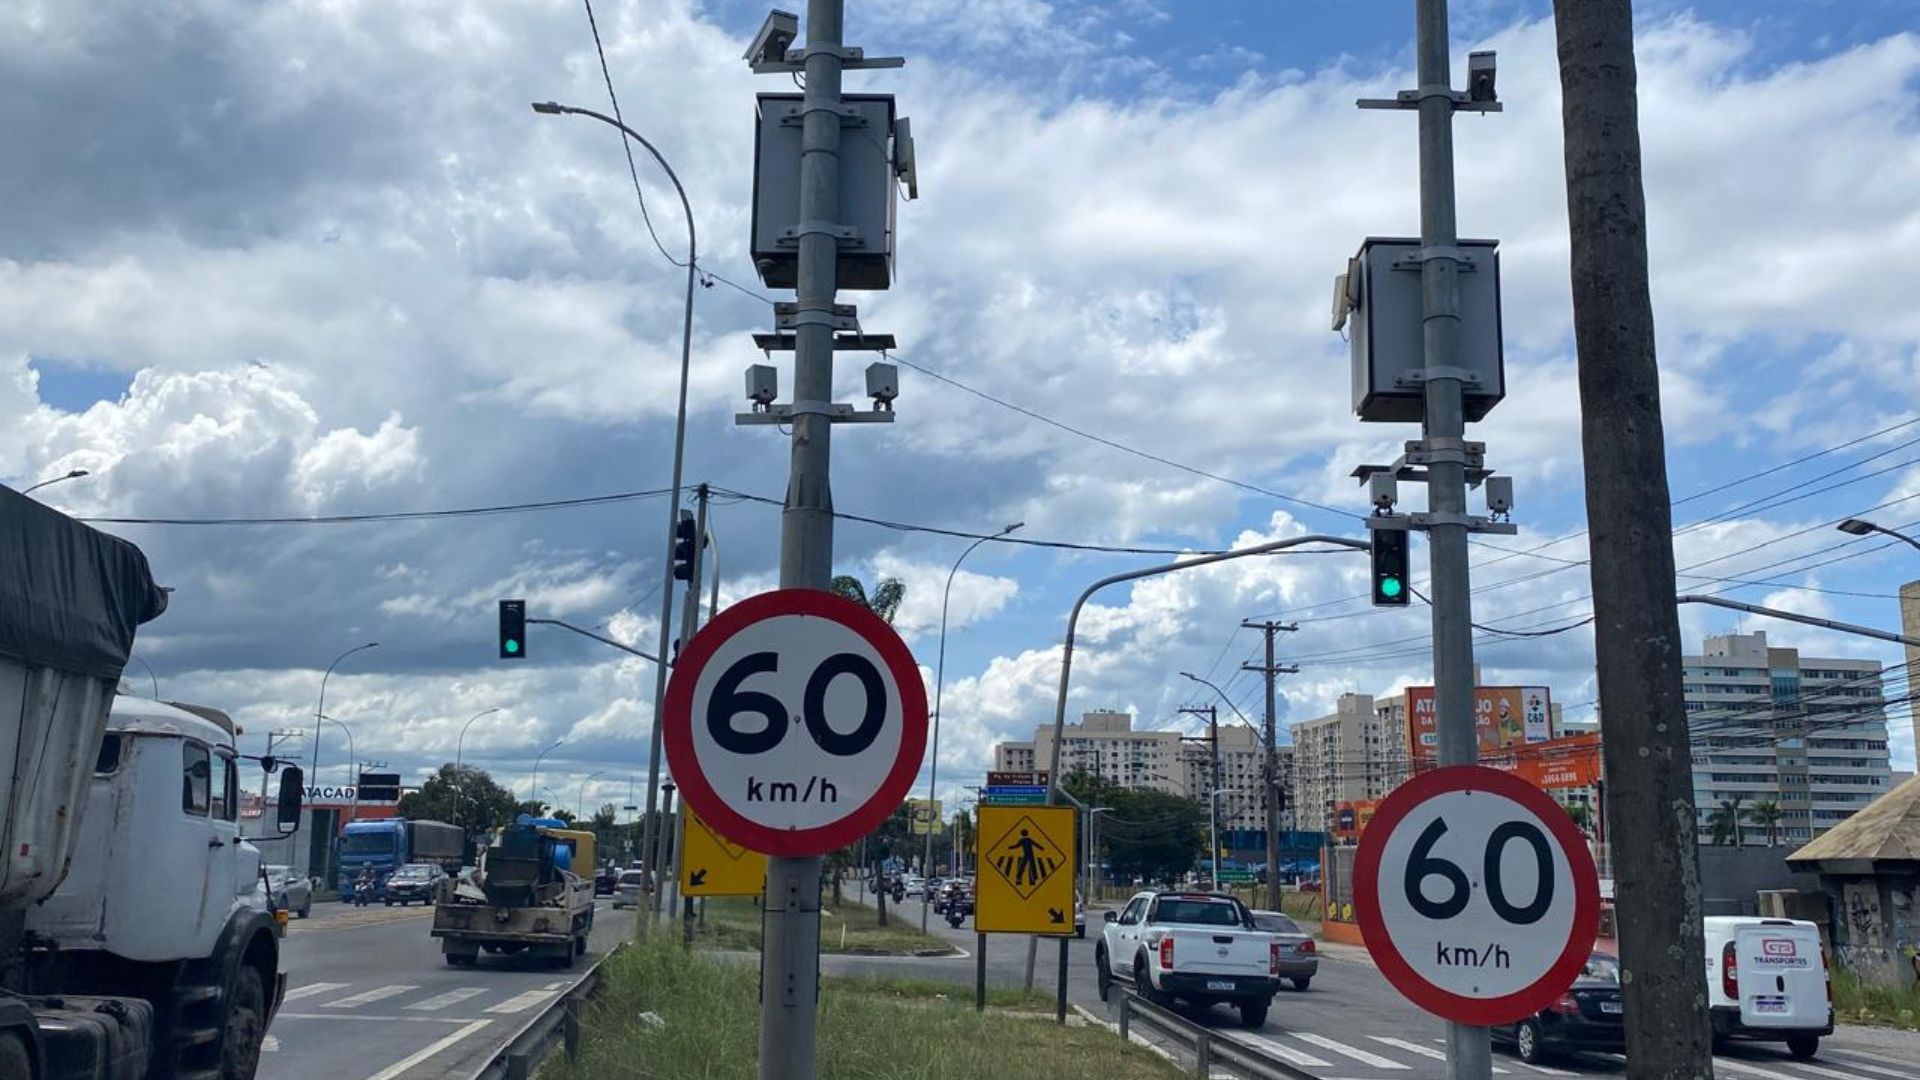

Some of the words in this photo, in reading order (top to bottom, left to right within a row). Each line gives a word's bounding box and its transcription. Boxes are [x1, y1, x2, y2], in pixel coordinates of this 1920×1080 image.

[706, 651, 887, 756] 60
[747, 776, 837, 802] km/h
[1404, 816, 1554, 925] 60
[1436, 941, 1510, 968] km/h
